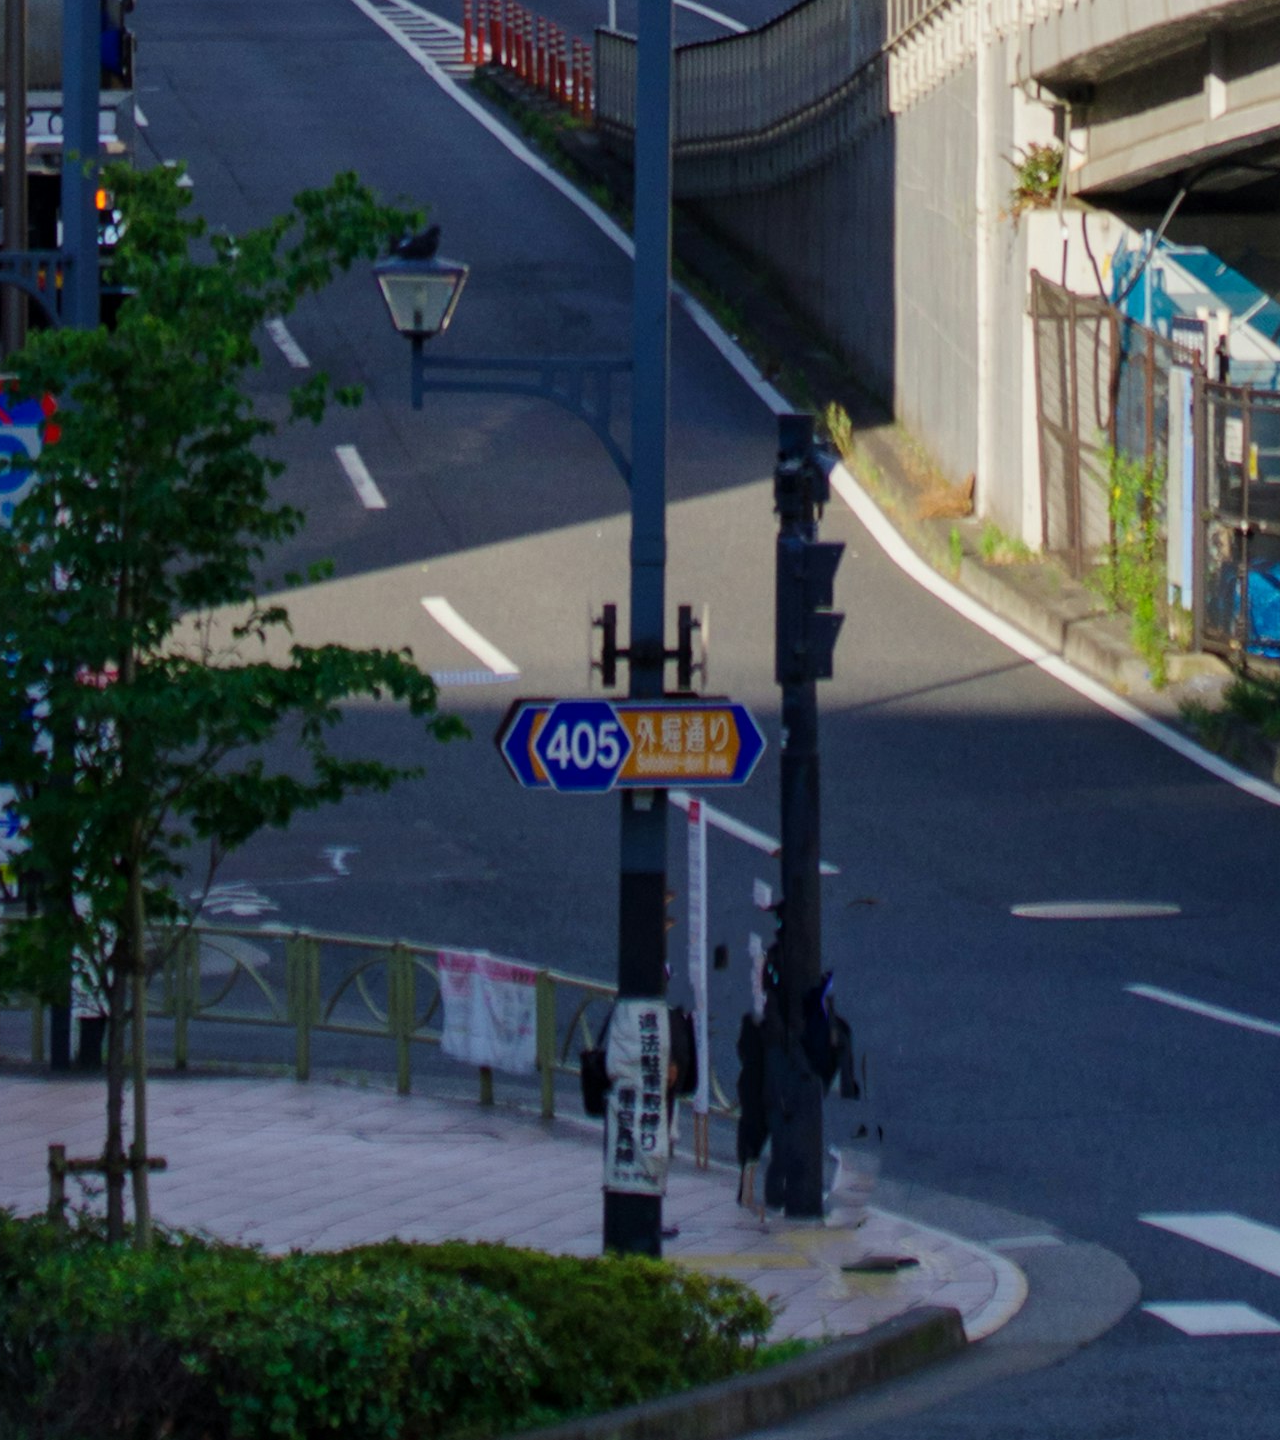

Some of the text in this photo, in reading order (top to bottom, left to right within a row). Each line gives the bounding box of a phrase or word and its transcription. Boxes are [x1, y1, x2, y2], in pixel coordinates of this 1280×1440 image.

[546, 721, 620, 770] 405
[636, 715, 730, 754] 外堀通り
